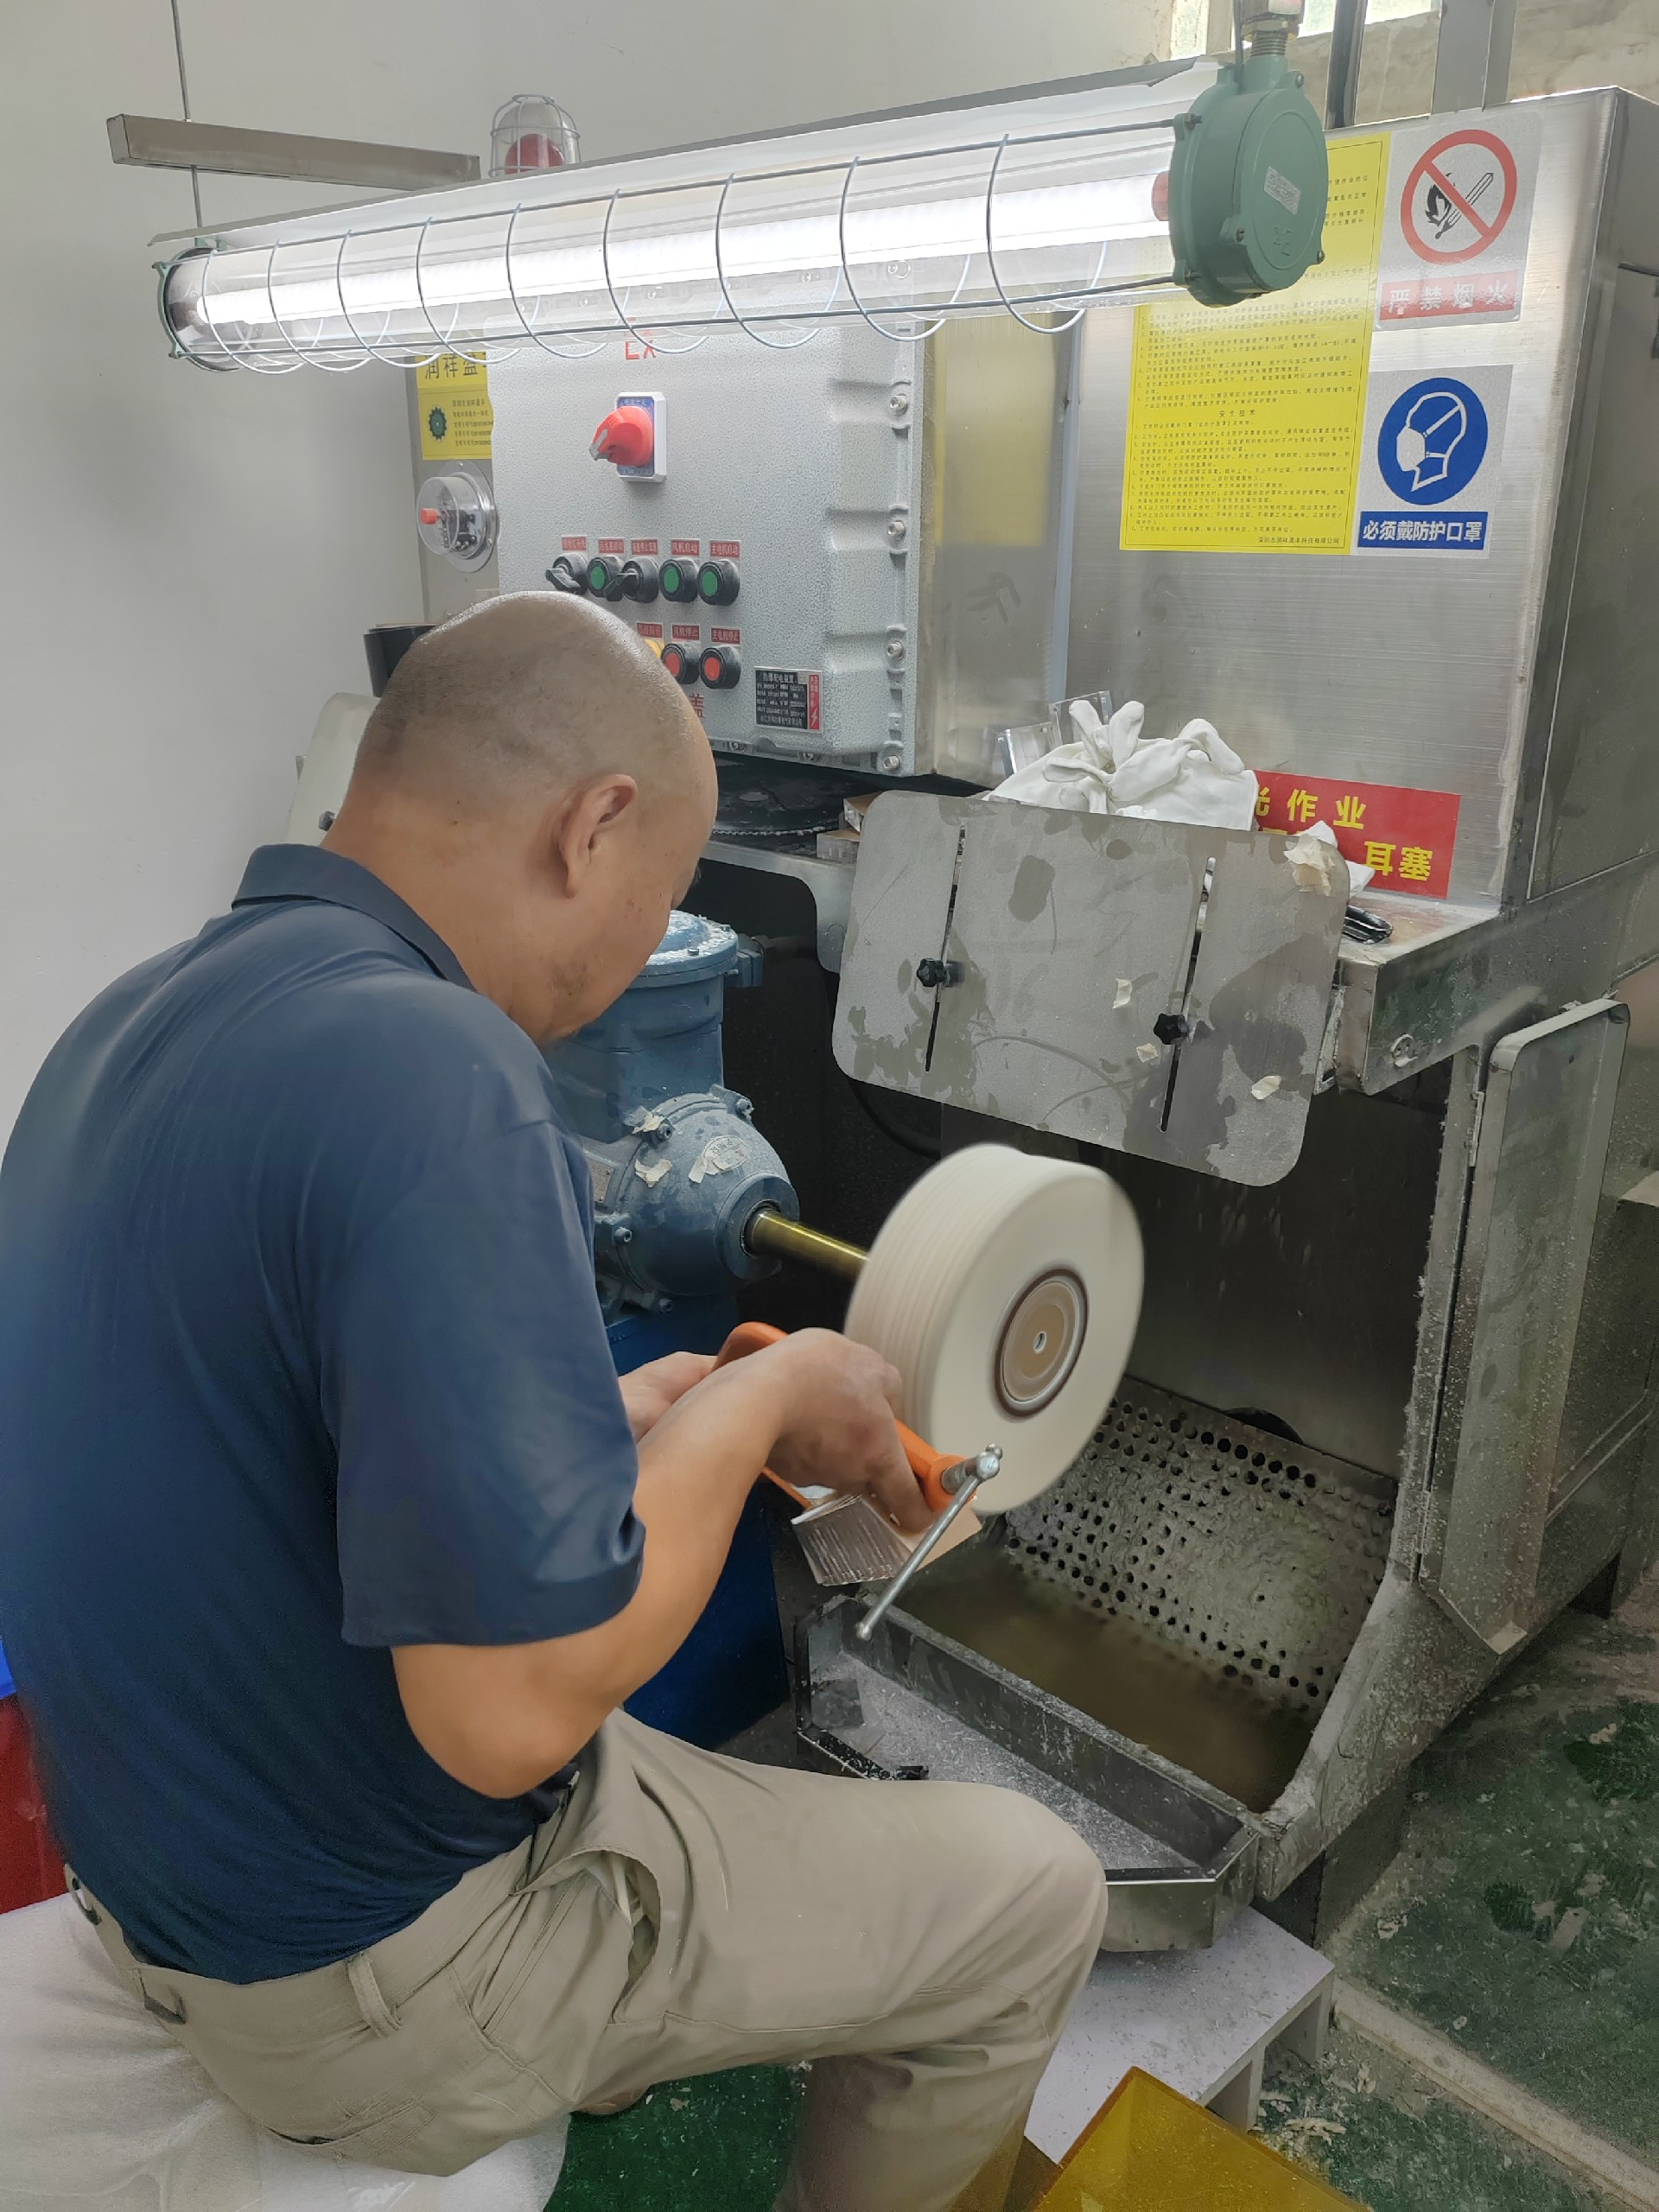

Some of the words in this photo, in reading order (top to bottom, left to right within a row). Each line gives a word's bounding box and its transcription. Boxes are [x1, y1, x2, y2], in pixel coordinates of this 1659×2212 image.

[1388, 279, 1508, 315] 严禁烟火
[424, 353, 486, 380] 润祥盈
[1363, 519, 1483, 543] 必须戴防护口罩
[1363, 841, 1433, 881] 耳塞
